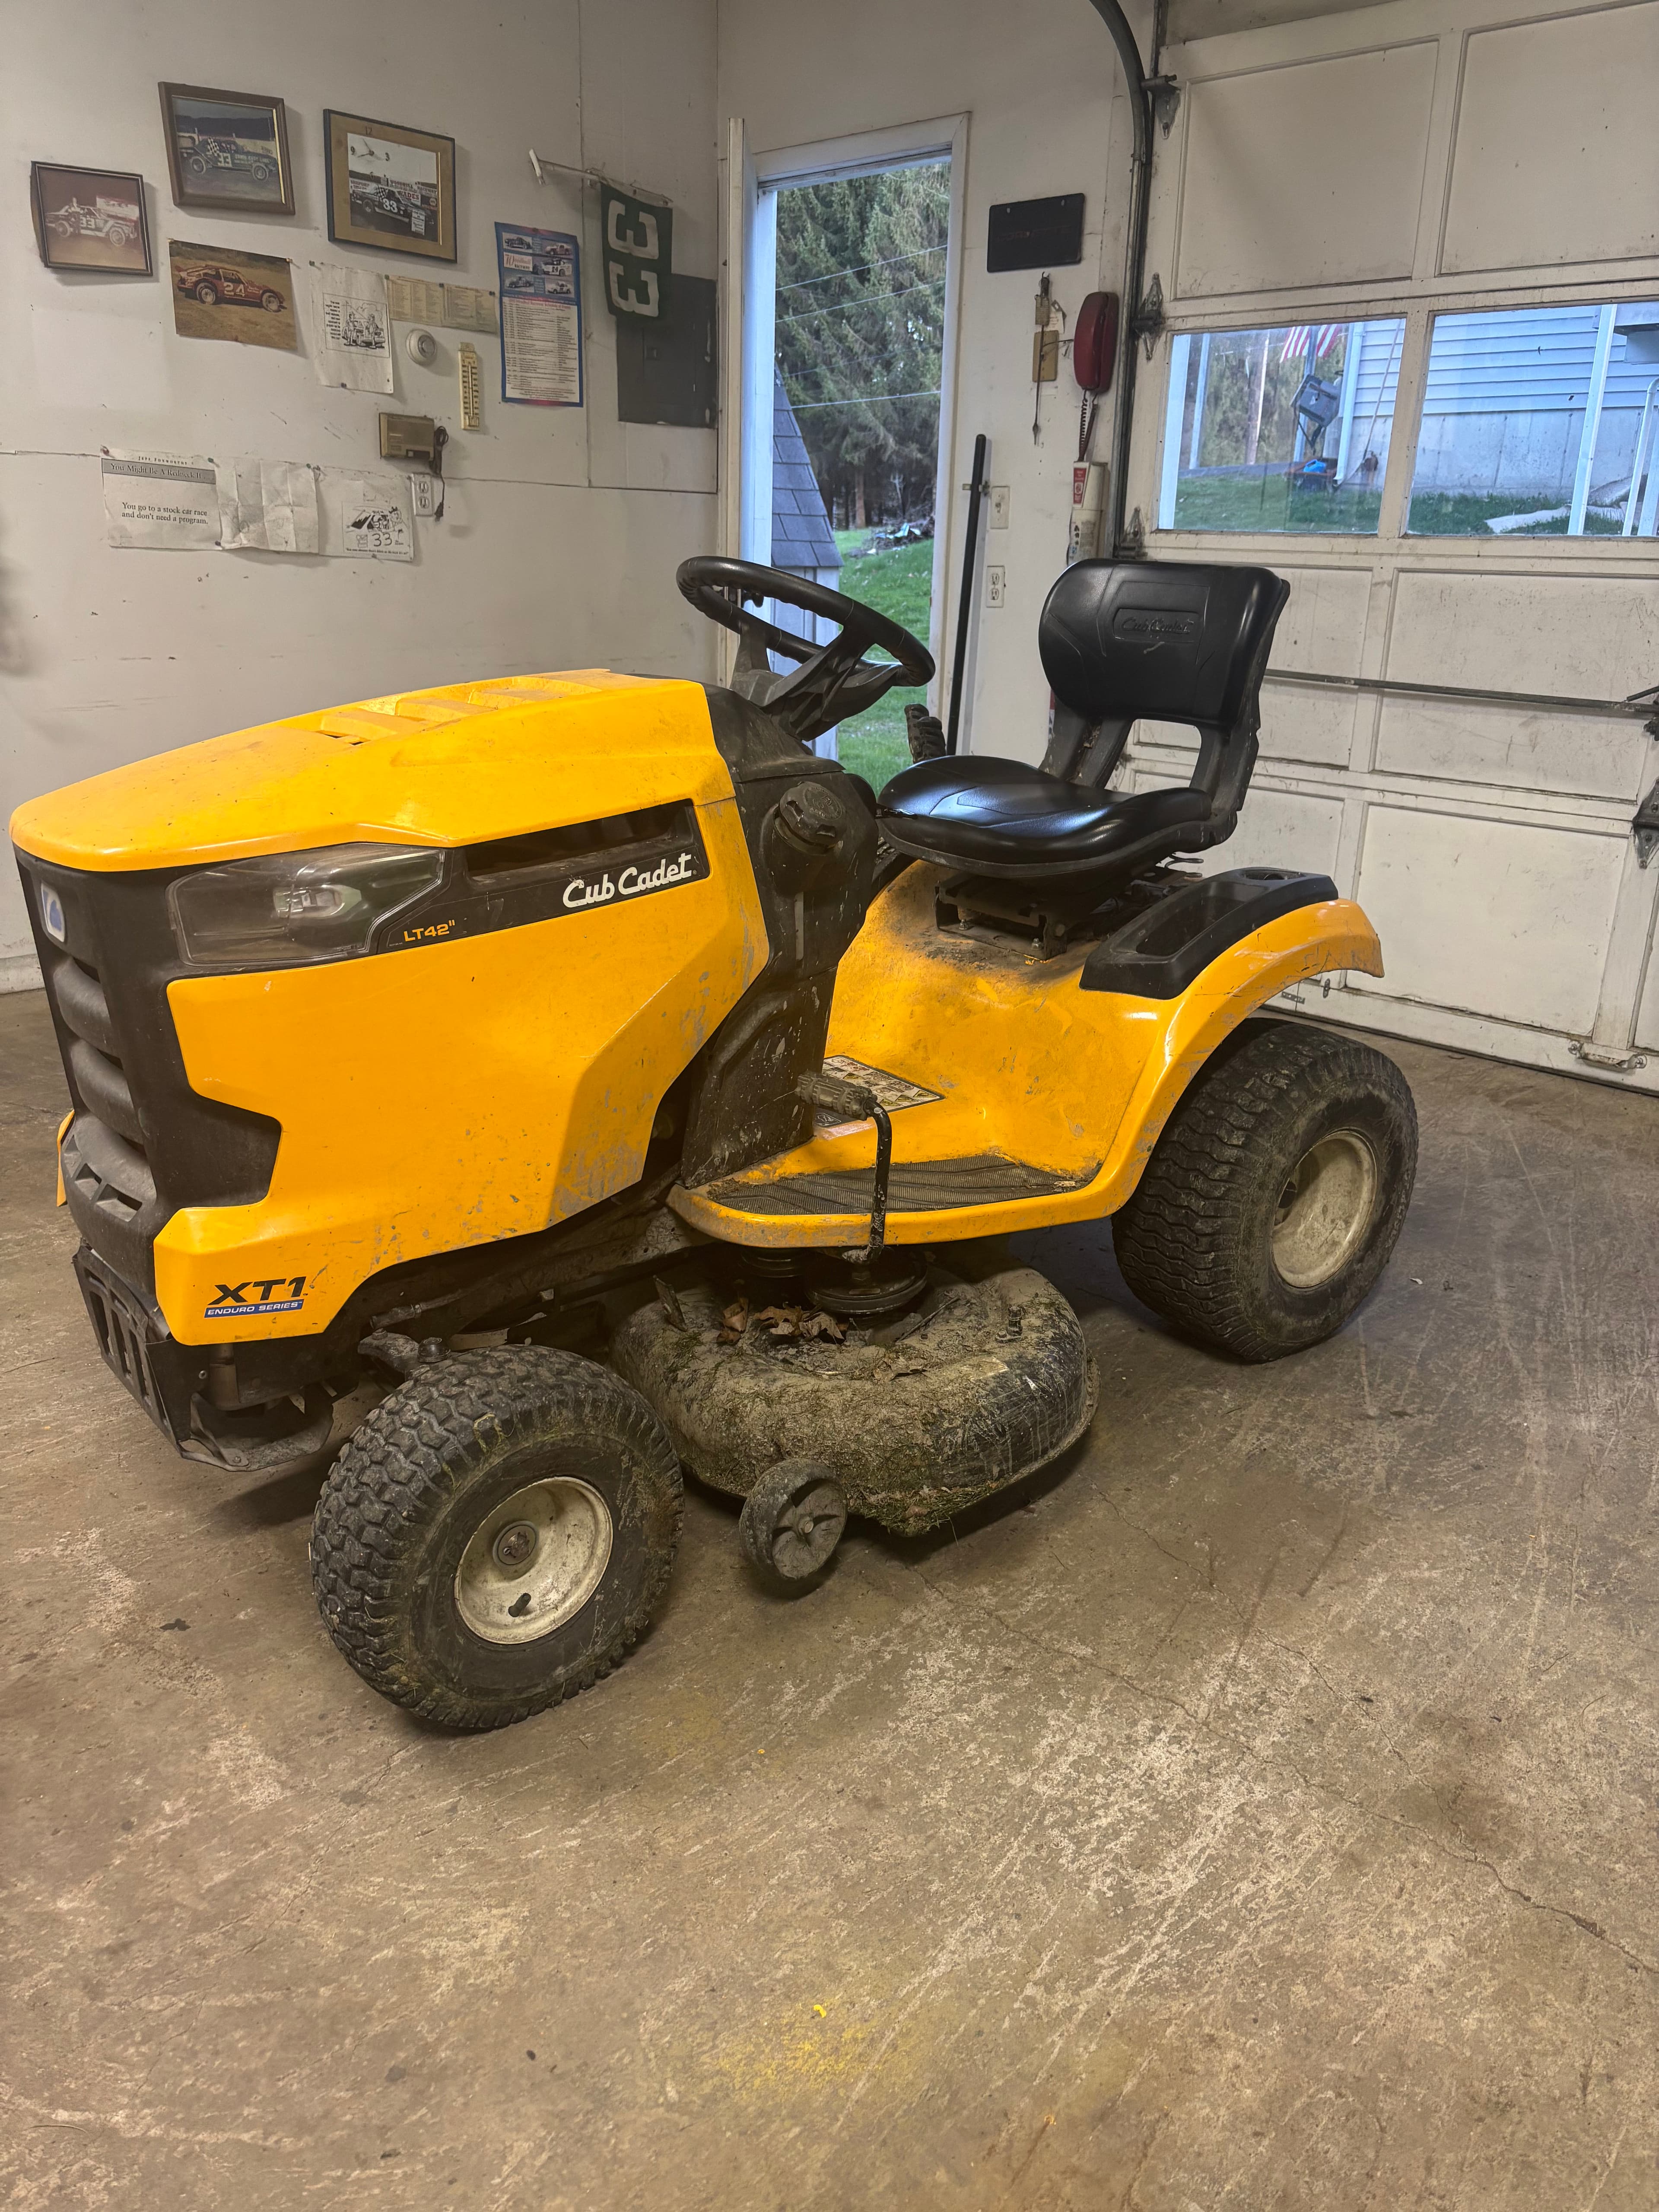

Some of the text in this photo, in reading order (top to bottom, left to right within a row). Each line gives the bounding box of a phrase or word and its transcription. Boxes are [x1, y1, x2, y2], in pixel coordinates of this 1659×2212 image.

[350, 146, 355, 156] 9
[385, 152, 390, 162] 3
[383, 198, 398, 213] 33
[79, 216, 95, 229] 33
[607, 199, 659, 317] 33
[223, 282, 245, 298] 24
[111, 463, 124, 471] You
[127, 465, 147, 474] Might
[167, 469, 195, 478] Redneck
[122, 502, 136, 510] You
[179, 516, 208, 524] program.
[372, 533, 392, 547] 33
[563, 852, 692, 908] Cub Cadet
[403, 919, 455, 942] LT42"
[207, 1276, 307, 1306] XT1
[207, 1301, 298, 1316] ENDURO SERIES
